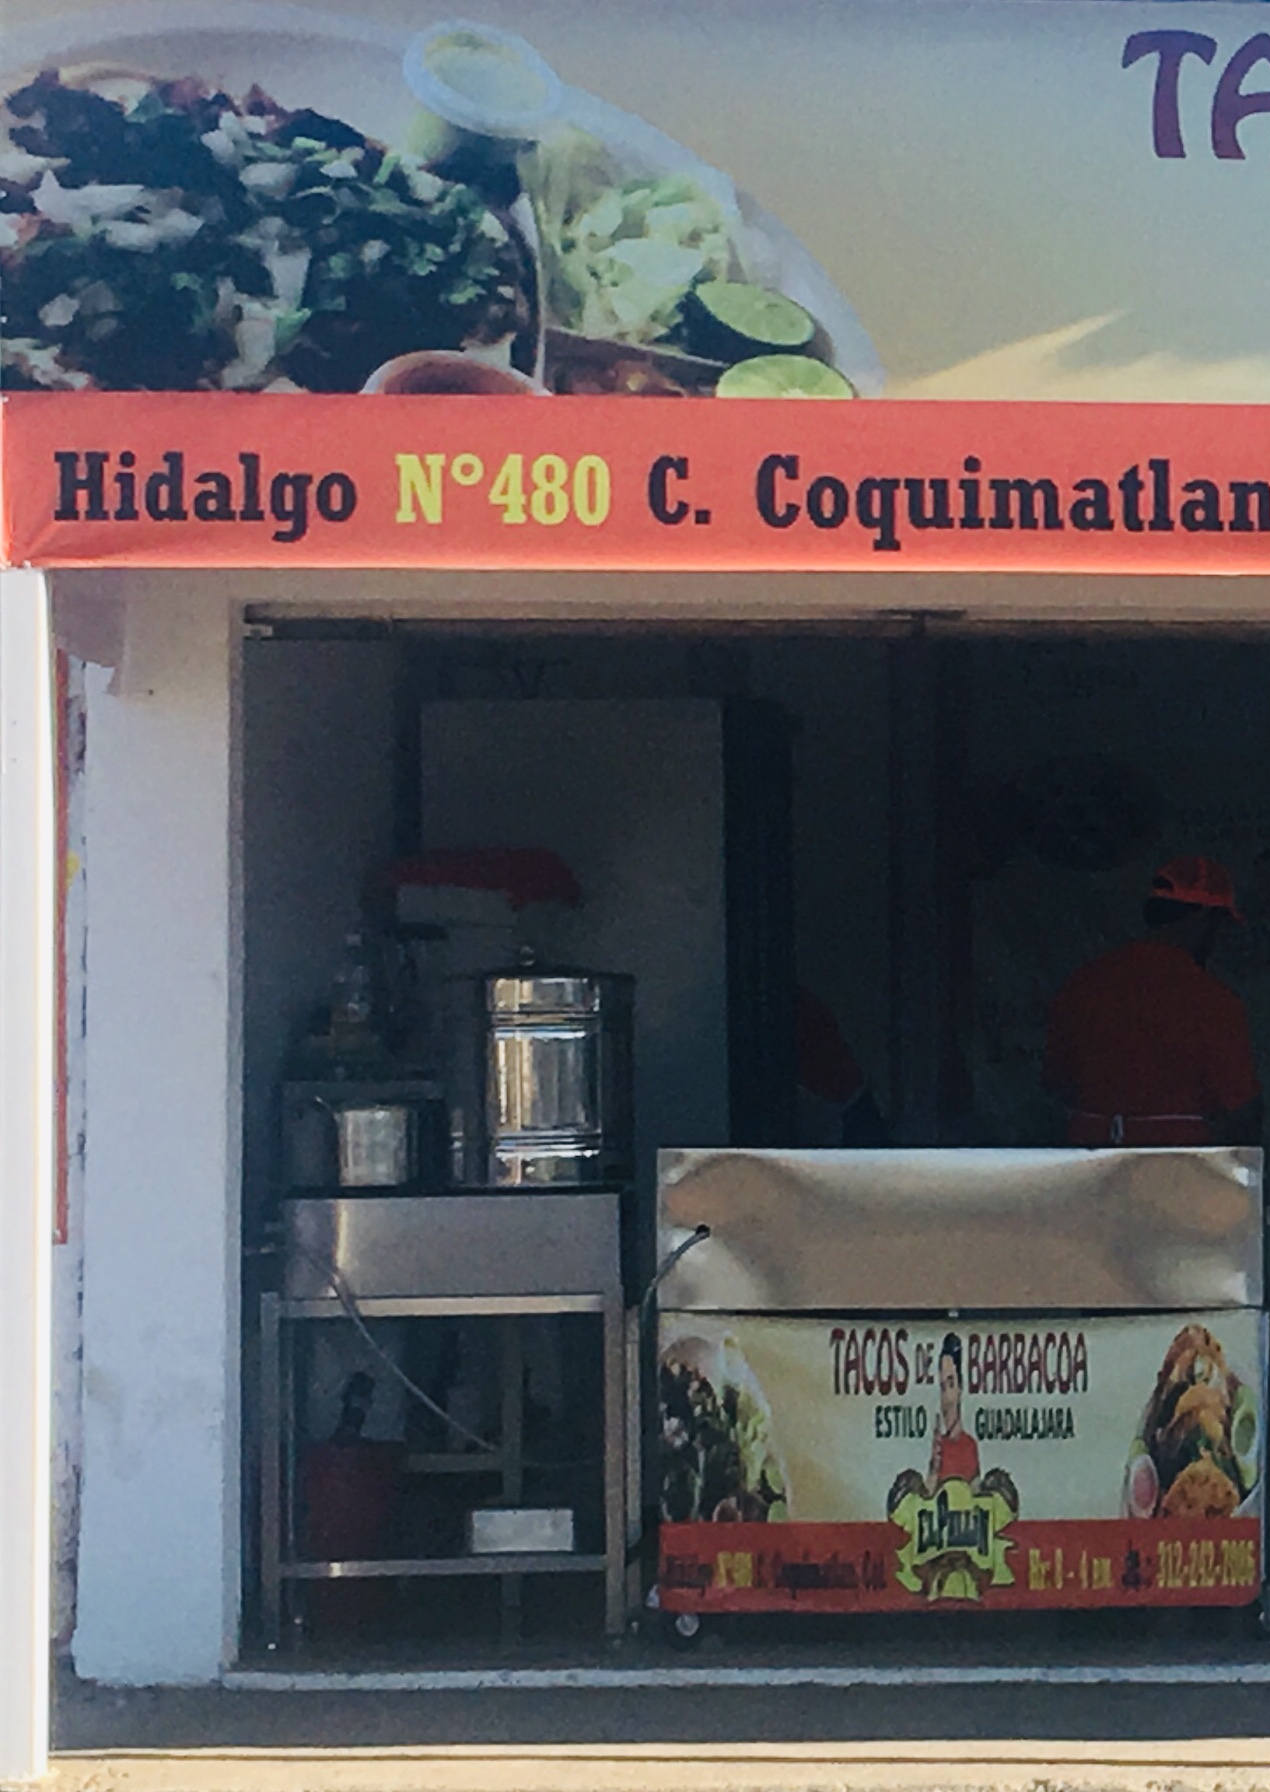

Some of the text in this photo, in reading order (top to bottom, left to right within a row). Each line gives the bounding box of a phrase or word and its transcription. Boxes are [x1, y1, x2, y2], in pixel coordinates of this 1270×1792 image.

[53, 450, 358, 543] Hidalgo
[395, 453, 612, 526] N°480
[647, 455, 712, 526] C.
[828, 1327, 1089, 1396] TACOS DE BARBACOA
[874, 1404, 1076, 1441] ESTILO GUADALAJARA
